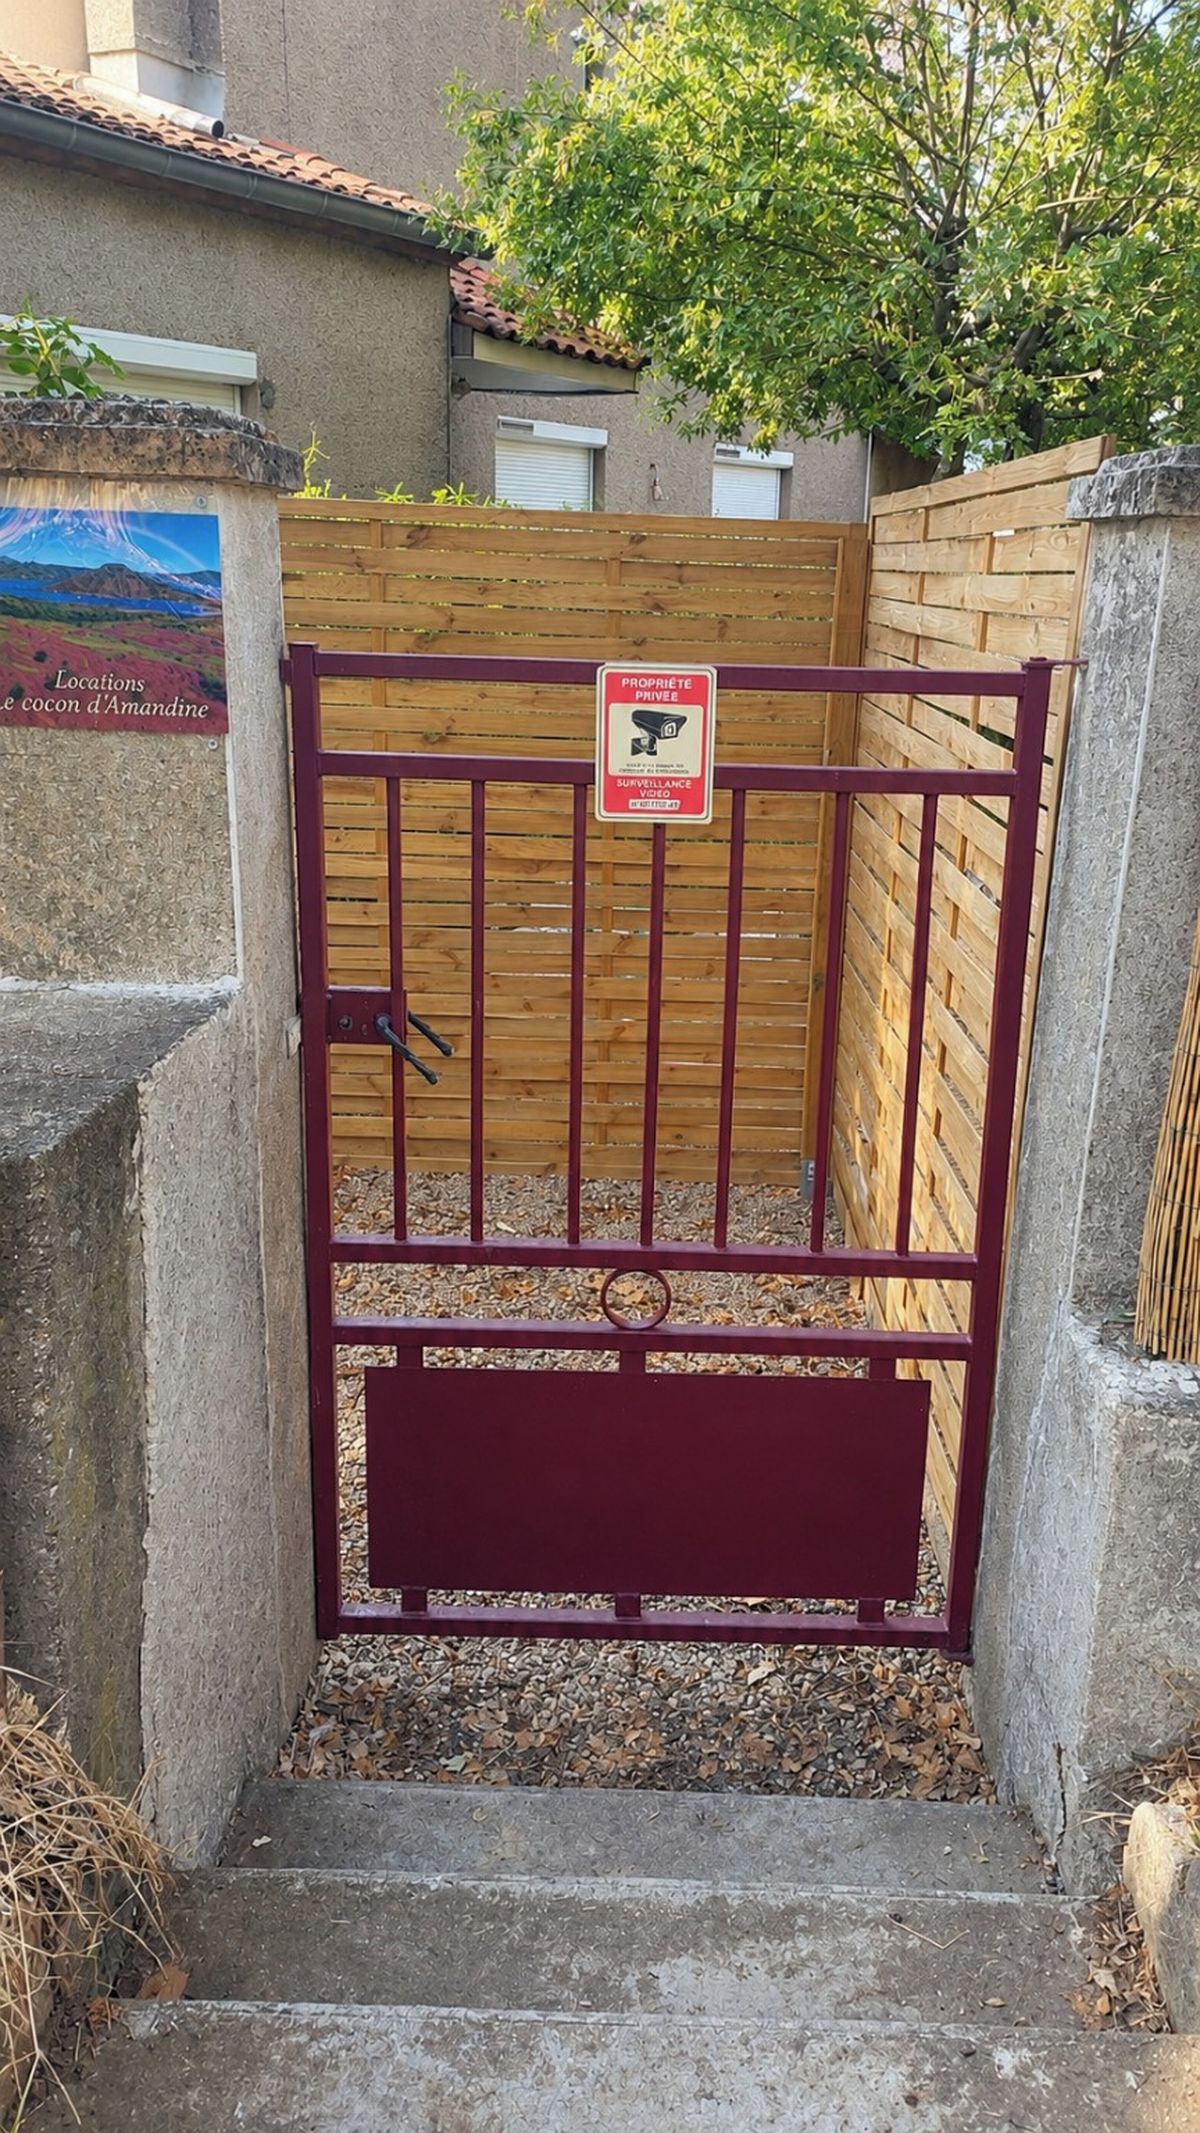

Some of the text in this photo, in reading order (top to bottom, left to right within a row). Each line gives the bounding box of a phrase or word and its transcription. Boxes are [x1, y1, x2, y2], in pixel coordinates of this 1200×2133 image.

[55, 670, 145, 692] Locations
[0, 694, 209, 719] e cocon d'Amandine
[616, 778, 692, 789] SURVEILLANCE
